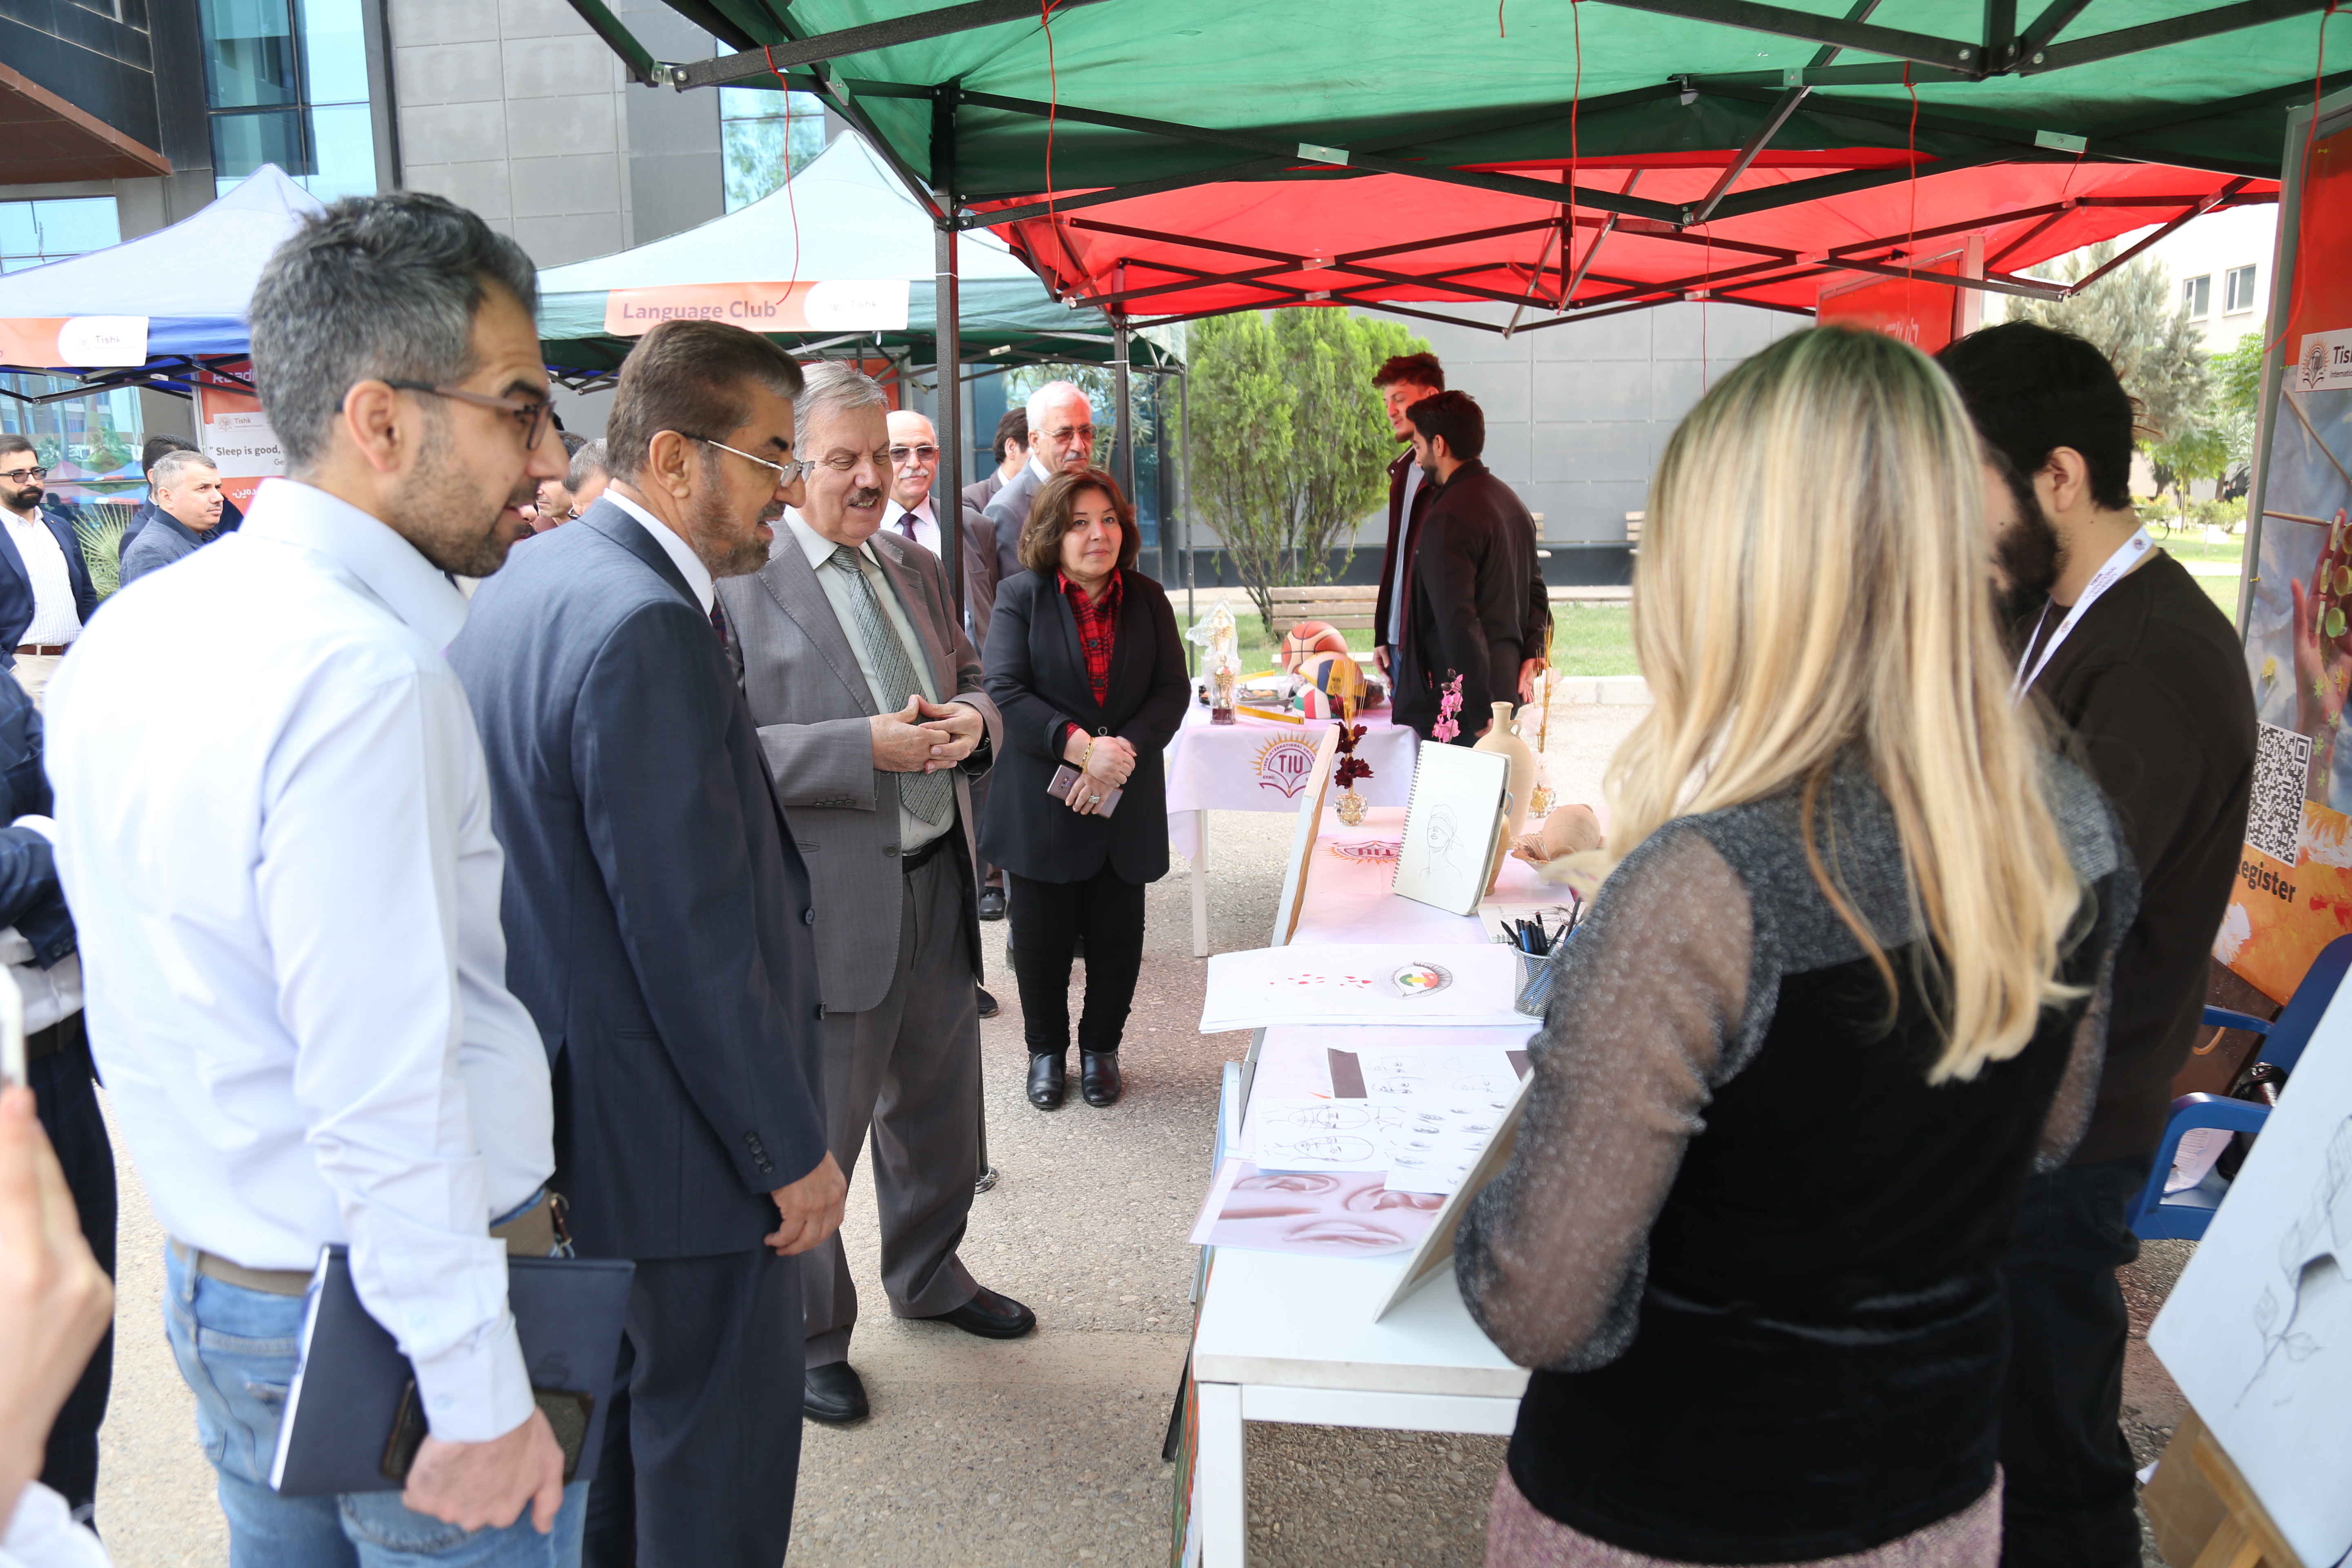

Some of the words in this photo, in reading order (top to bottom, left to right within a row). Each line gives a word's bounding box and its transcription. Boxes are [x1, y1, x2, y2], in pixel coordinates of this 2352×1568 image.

[623, 303, 724, 322] Language
[729, 300, 777, 318] Club
[95, 335, 120, 343] Tishk
[216, 447, 242, 457] Sleep
[244, 445, 252, 455] is
[255, 445, 281, 457] good,
[1268, 743, 1302, 758] INTERNATIONAL
[1278, 755, 1303, 774] TIU
[2237, 860, 2296, 903] egister
